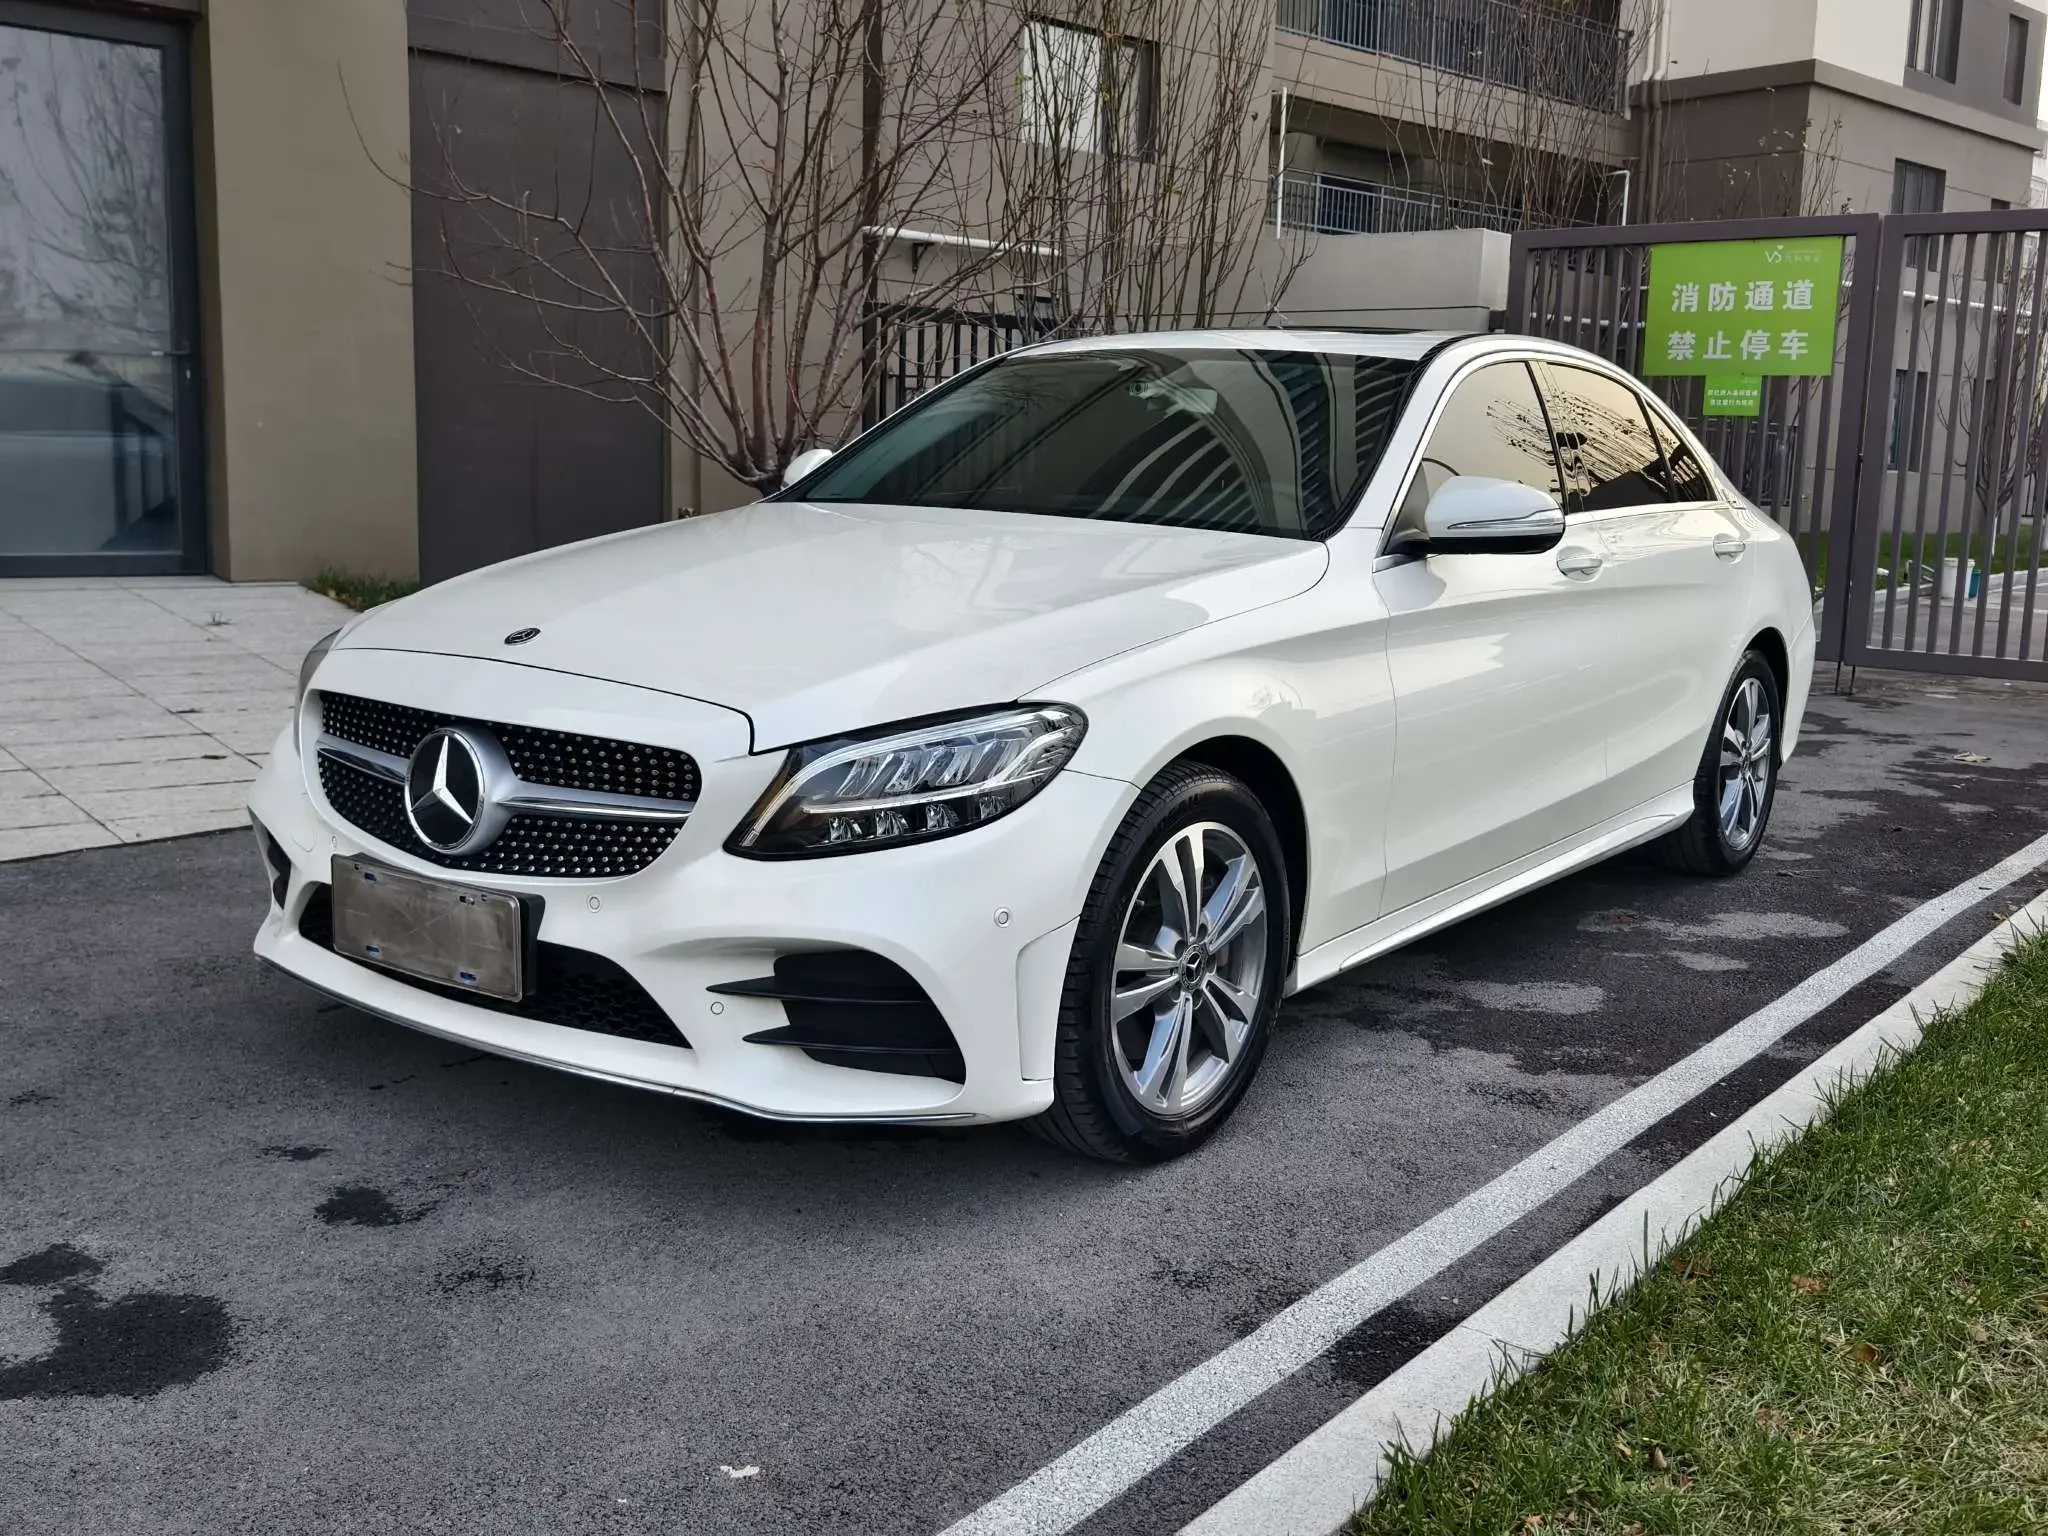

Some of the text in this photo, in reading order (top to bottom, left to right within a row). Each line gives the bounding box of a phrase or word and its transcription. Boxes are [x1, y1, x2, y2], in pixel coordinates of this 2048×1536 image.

[1672, 279, 1814, 312] 消防通道
[1667, 329, 1808, 360] 禁止停车
